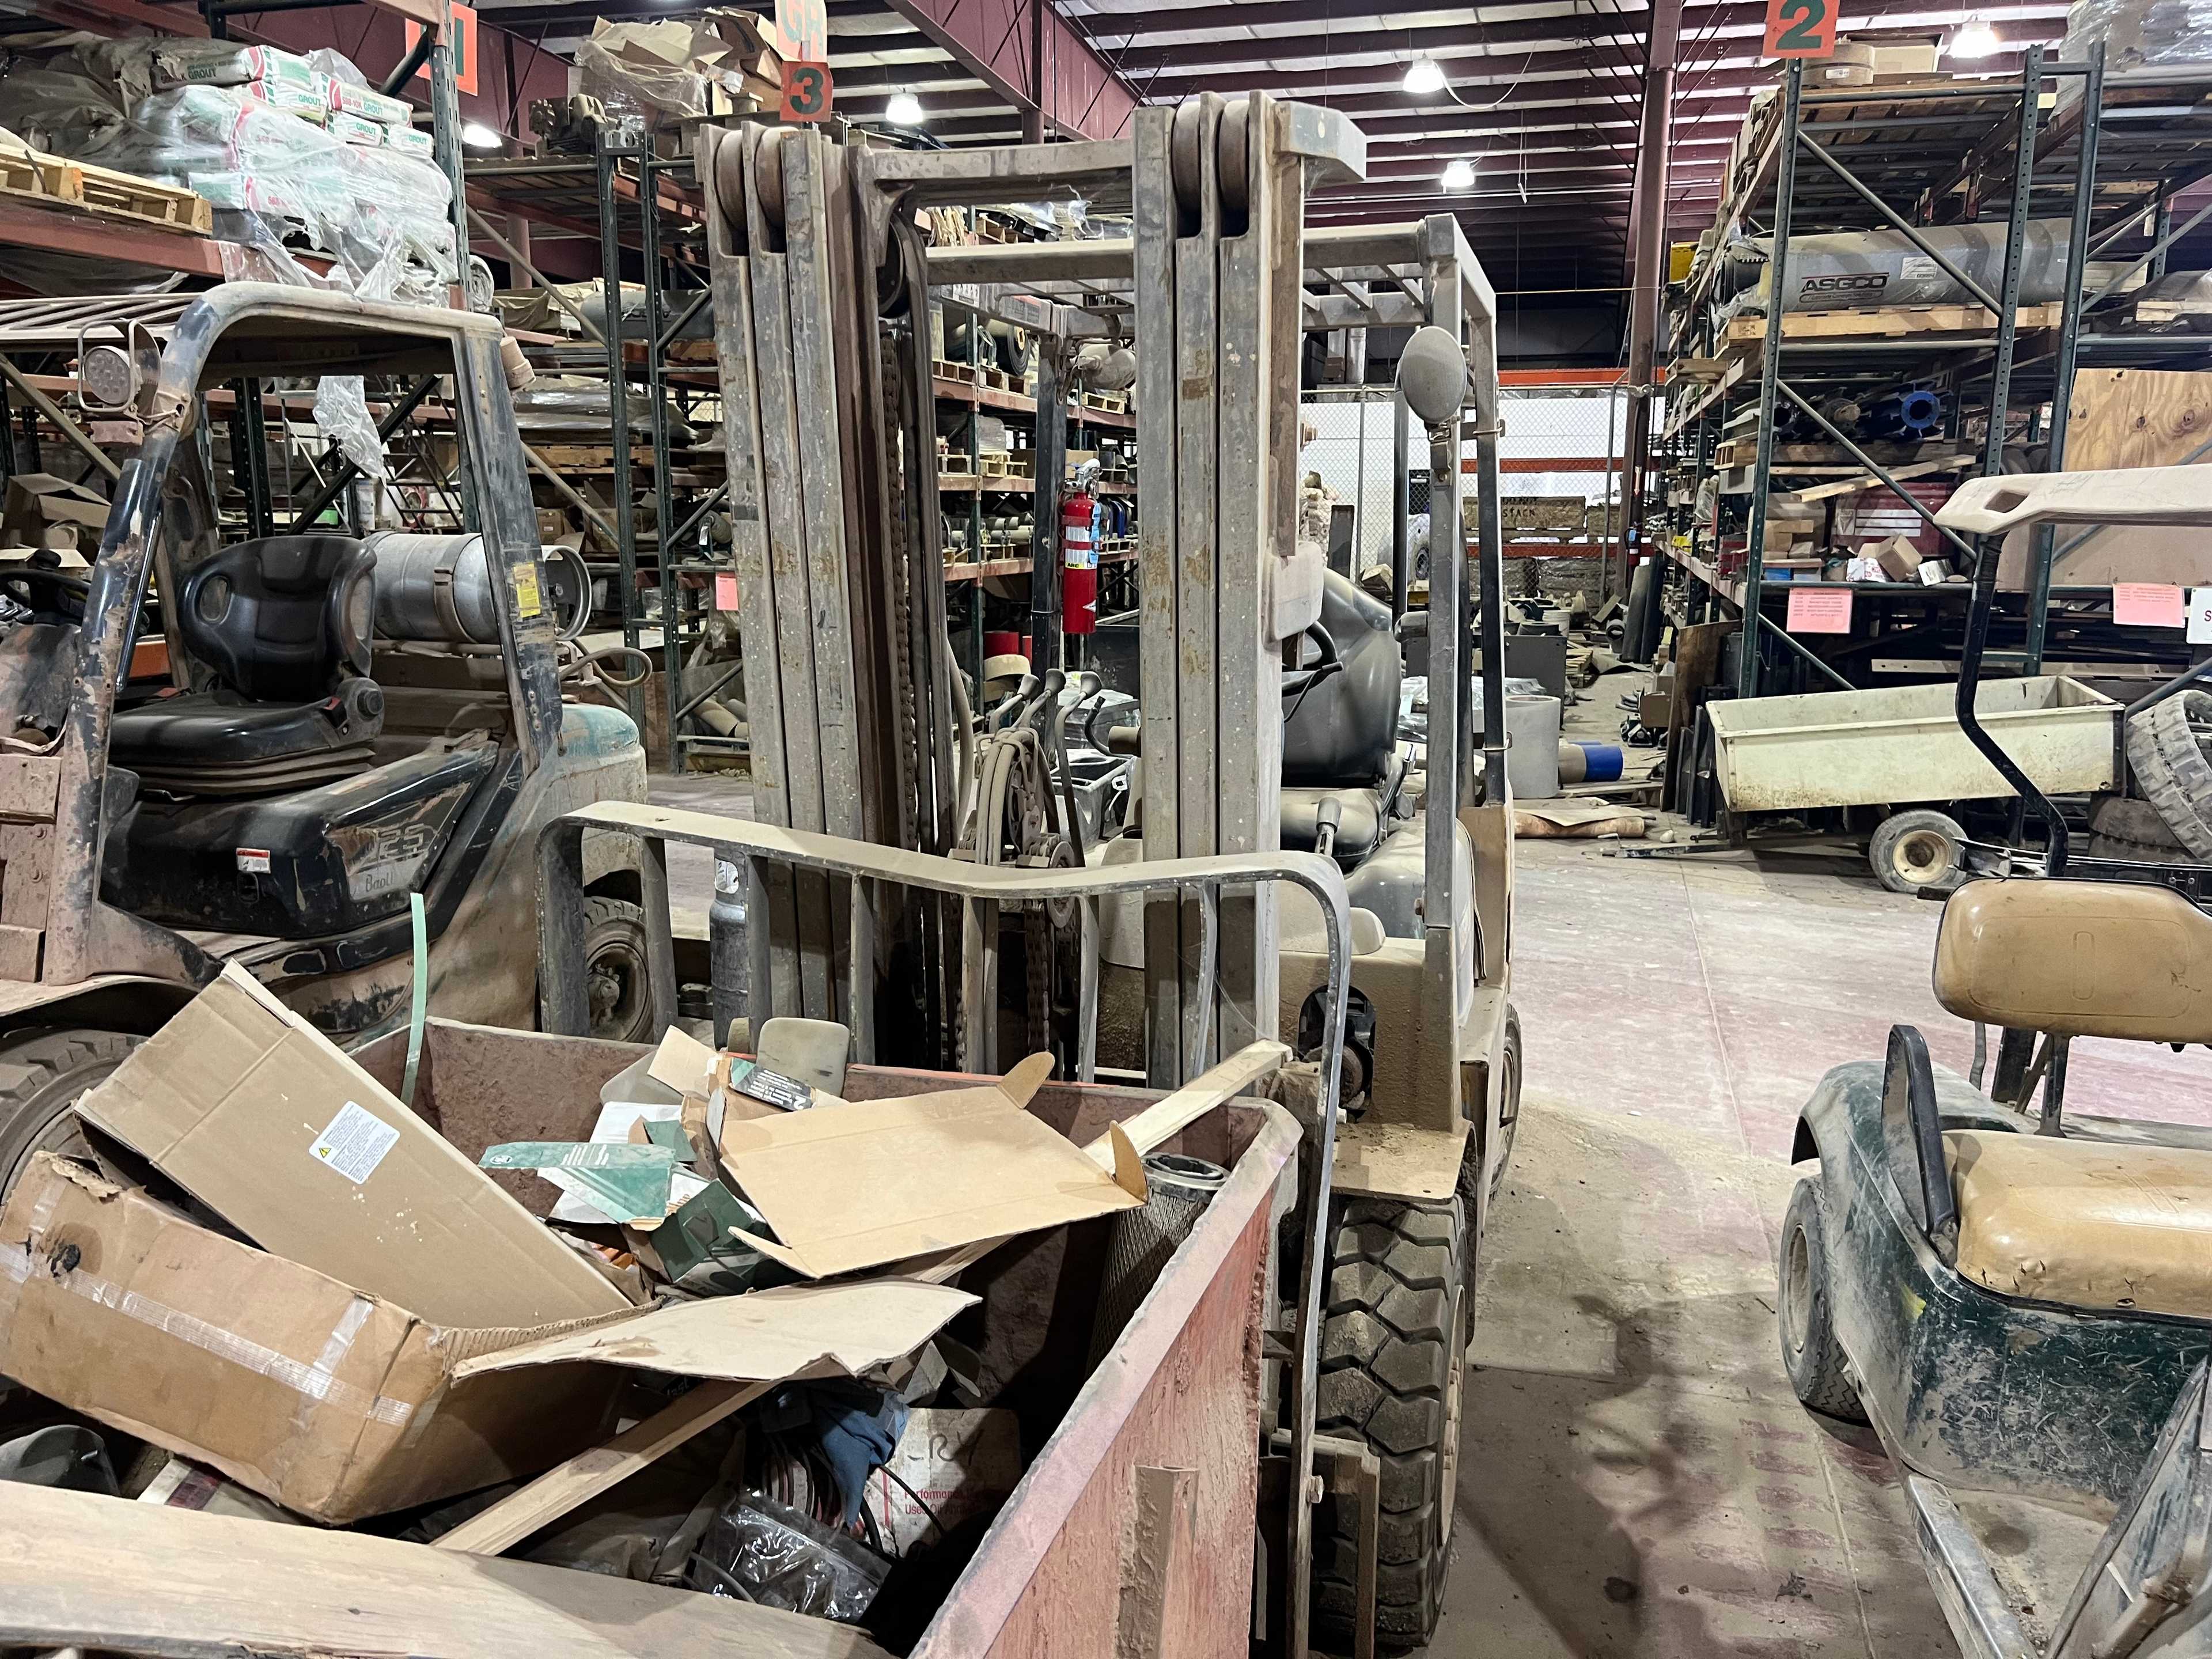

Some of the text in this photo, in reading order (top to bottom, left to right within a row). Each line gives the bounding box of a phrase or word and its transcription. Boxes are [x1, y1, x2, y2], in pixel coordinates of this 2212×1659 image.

[1776, 0, 1825, 50] 2
[188, 68, 217, 80] GROUT
[790, 67, 824, 114] 3
[298, 94, 321, 107] GROUT
[363, 102, 383, 115] GROUT
[355, 122, 376, 134] GROUT
[408, 134, 427, 145] GROUT
[1800, 275, 1888, 293] ASGCO
